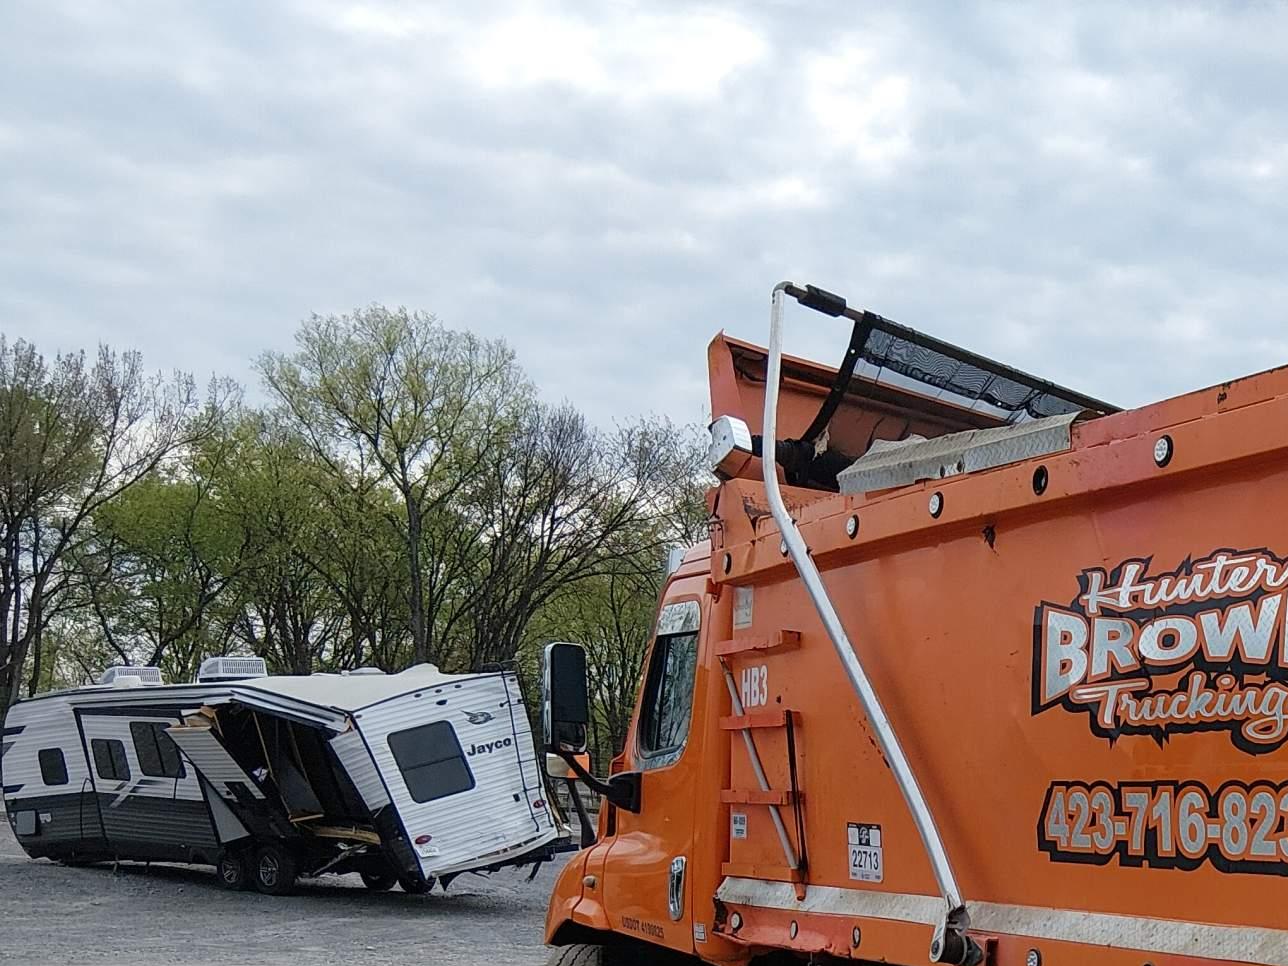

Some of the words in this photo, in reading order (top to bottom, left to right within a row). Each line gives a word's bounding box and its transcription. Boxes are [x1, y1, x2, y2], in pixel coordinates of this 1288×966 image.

[742, 664, 768, 708] HB3
[467, 737, 512, 757] Jayco
[852, 849, 879, 870] 22713
[621, 916, 640, 932] USDOT
